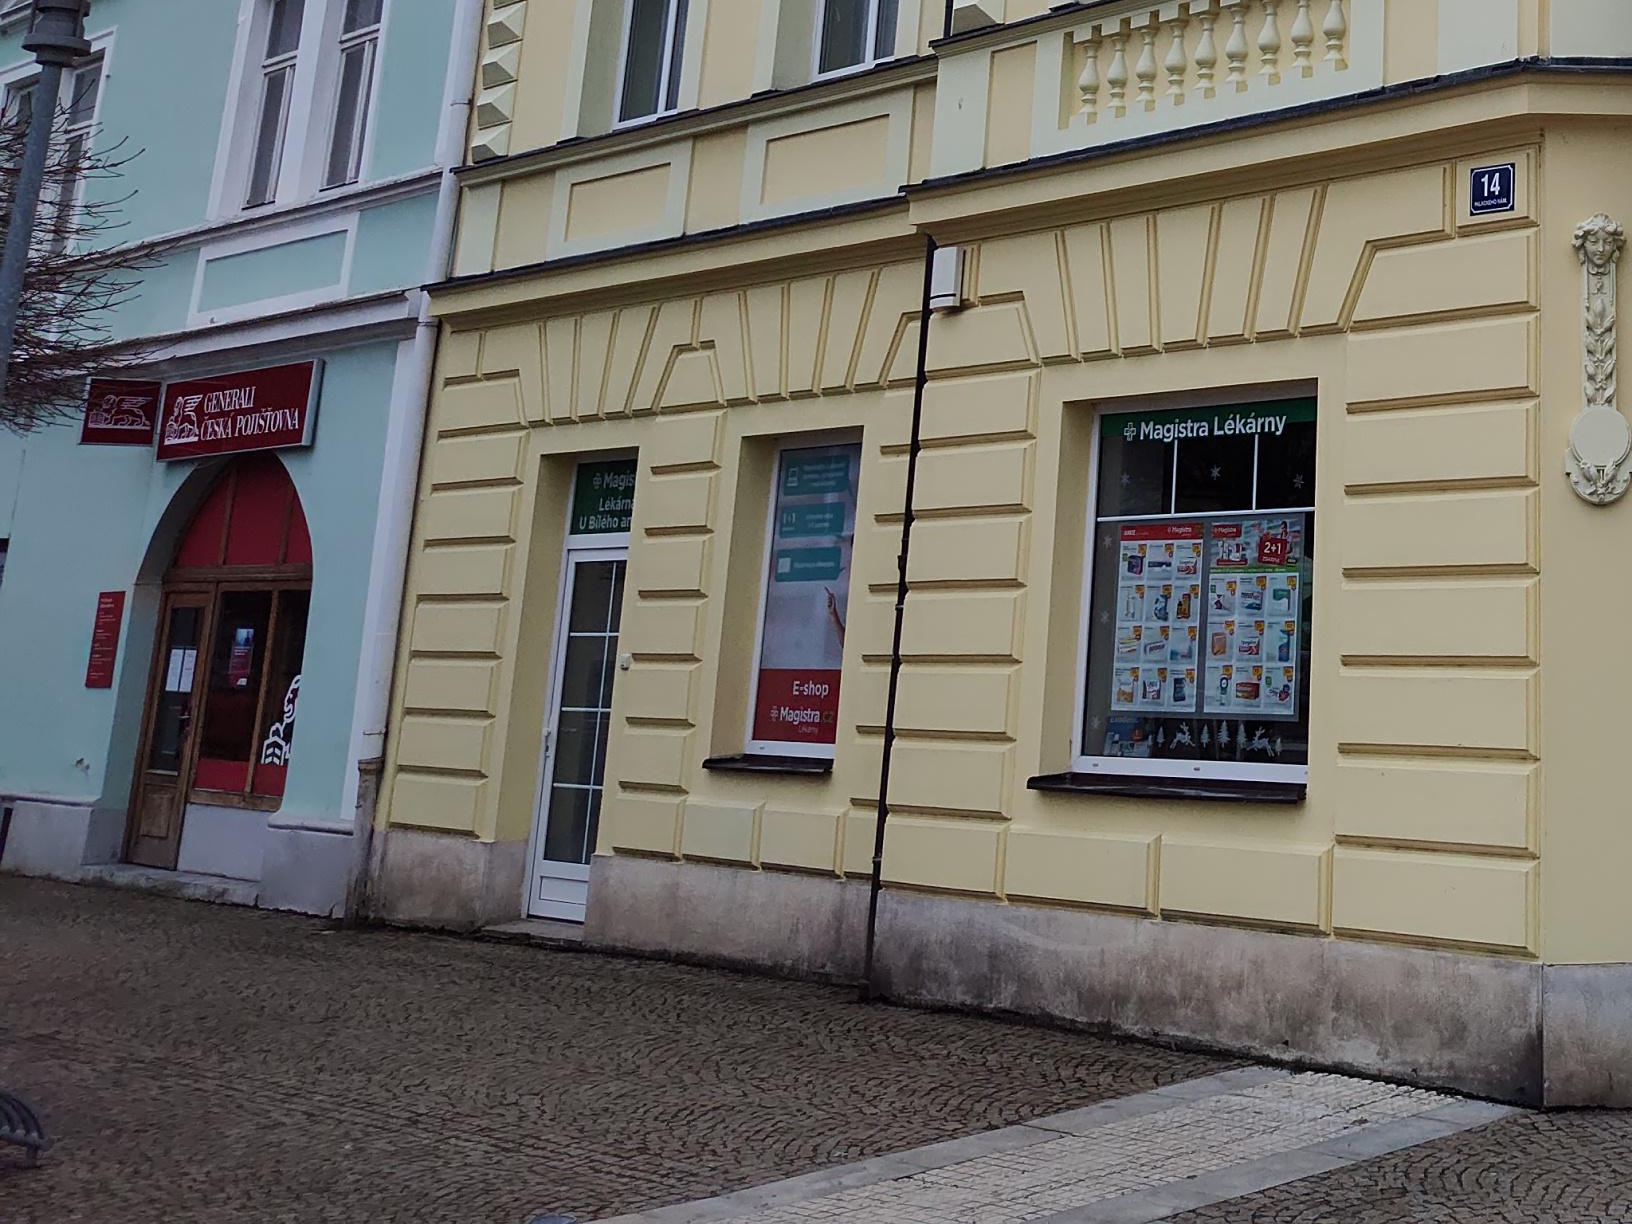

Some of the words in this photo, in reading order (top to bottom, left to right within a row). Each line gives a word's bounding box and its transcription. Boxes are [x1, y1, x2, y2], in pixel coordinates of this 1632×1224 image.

[1481, 172, 1501, 196] 14
[204, 386, 256, 413] GENERALI
[200, 411, 234, 441] ČESKÁ
[234, 407, 299, 437] POJIŠŤOVNA
[1140, 417, 1209, 443] Magistra
[1213, 412, 1287, 436] Lékárny
[580, 516, 586, 530] U
[588, 515, 619, 530] Bílého
[1264, 542, 1281, 554] 2+1
[792, 680, 829, 699] E-shop
